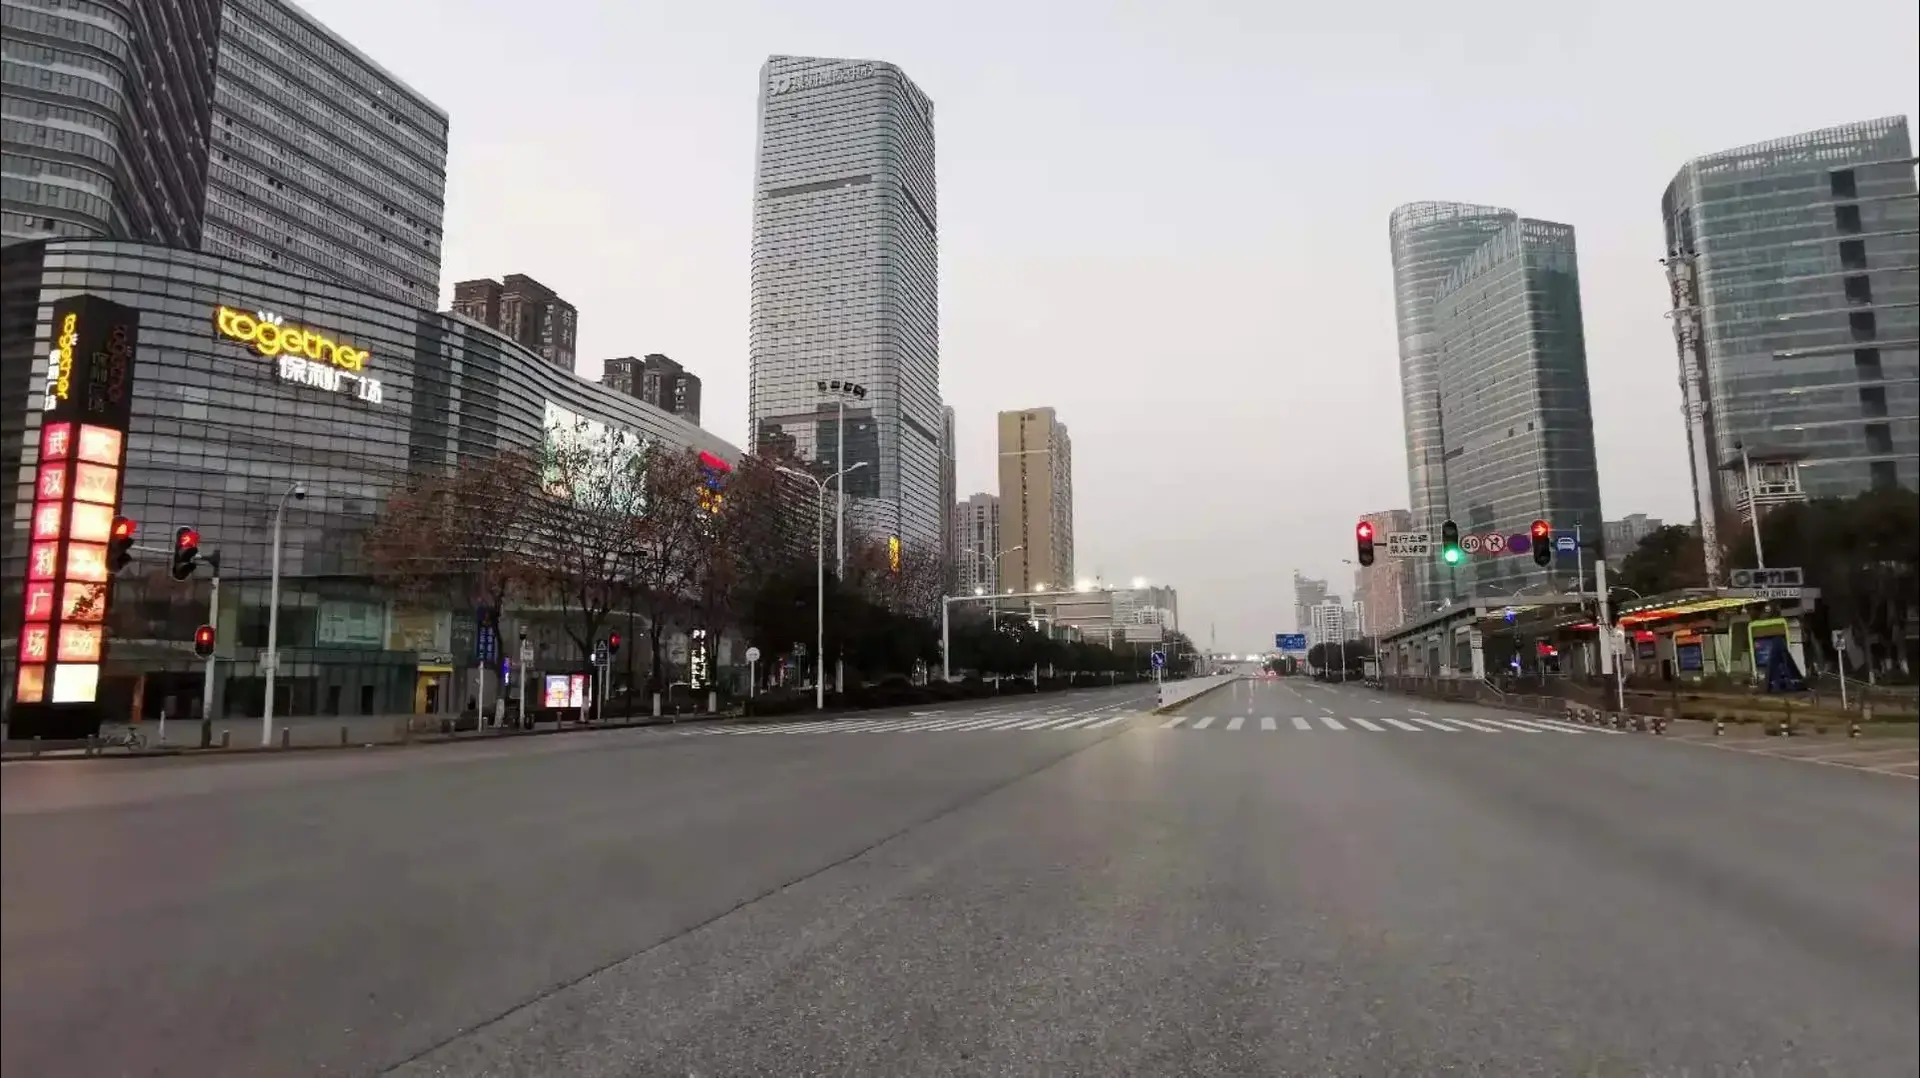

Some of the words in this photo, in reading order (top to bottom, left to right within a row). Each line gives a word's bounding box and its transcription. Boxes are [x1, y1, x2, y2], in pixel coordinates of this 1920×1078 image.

[58, 313, 77, 400] together
[218, 306, 370, 371] together
[279, 354, 383, 404] 保利广场
[27, 430, 68, 657] 武汉保利广场
[1464, 537, 1478, 548] 60
